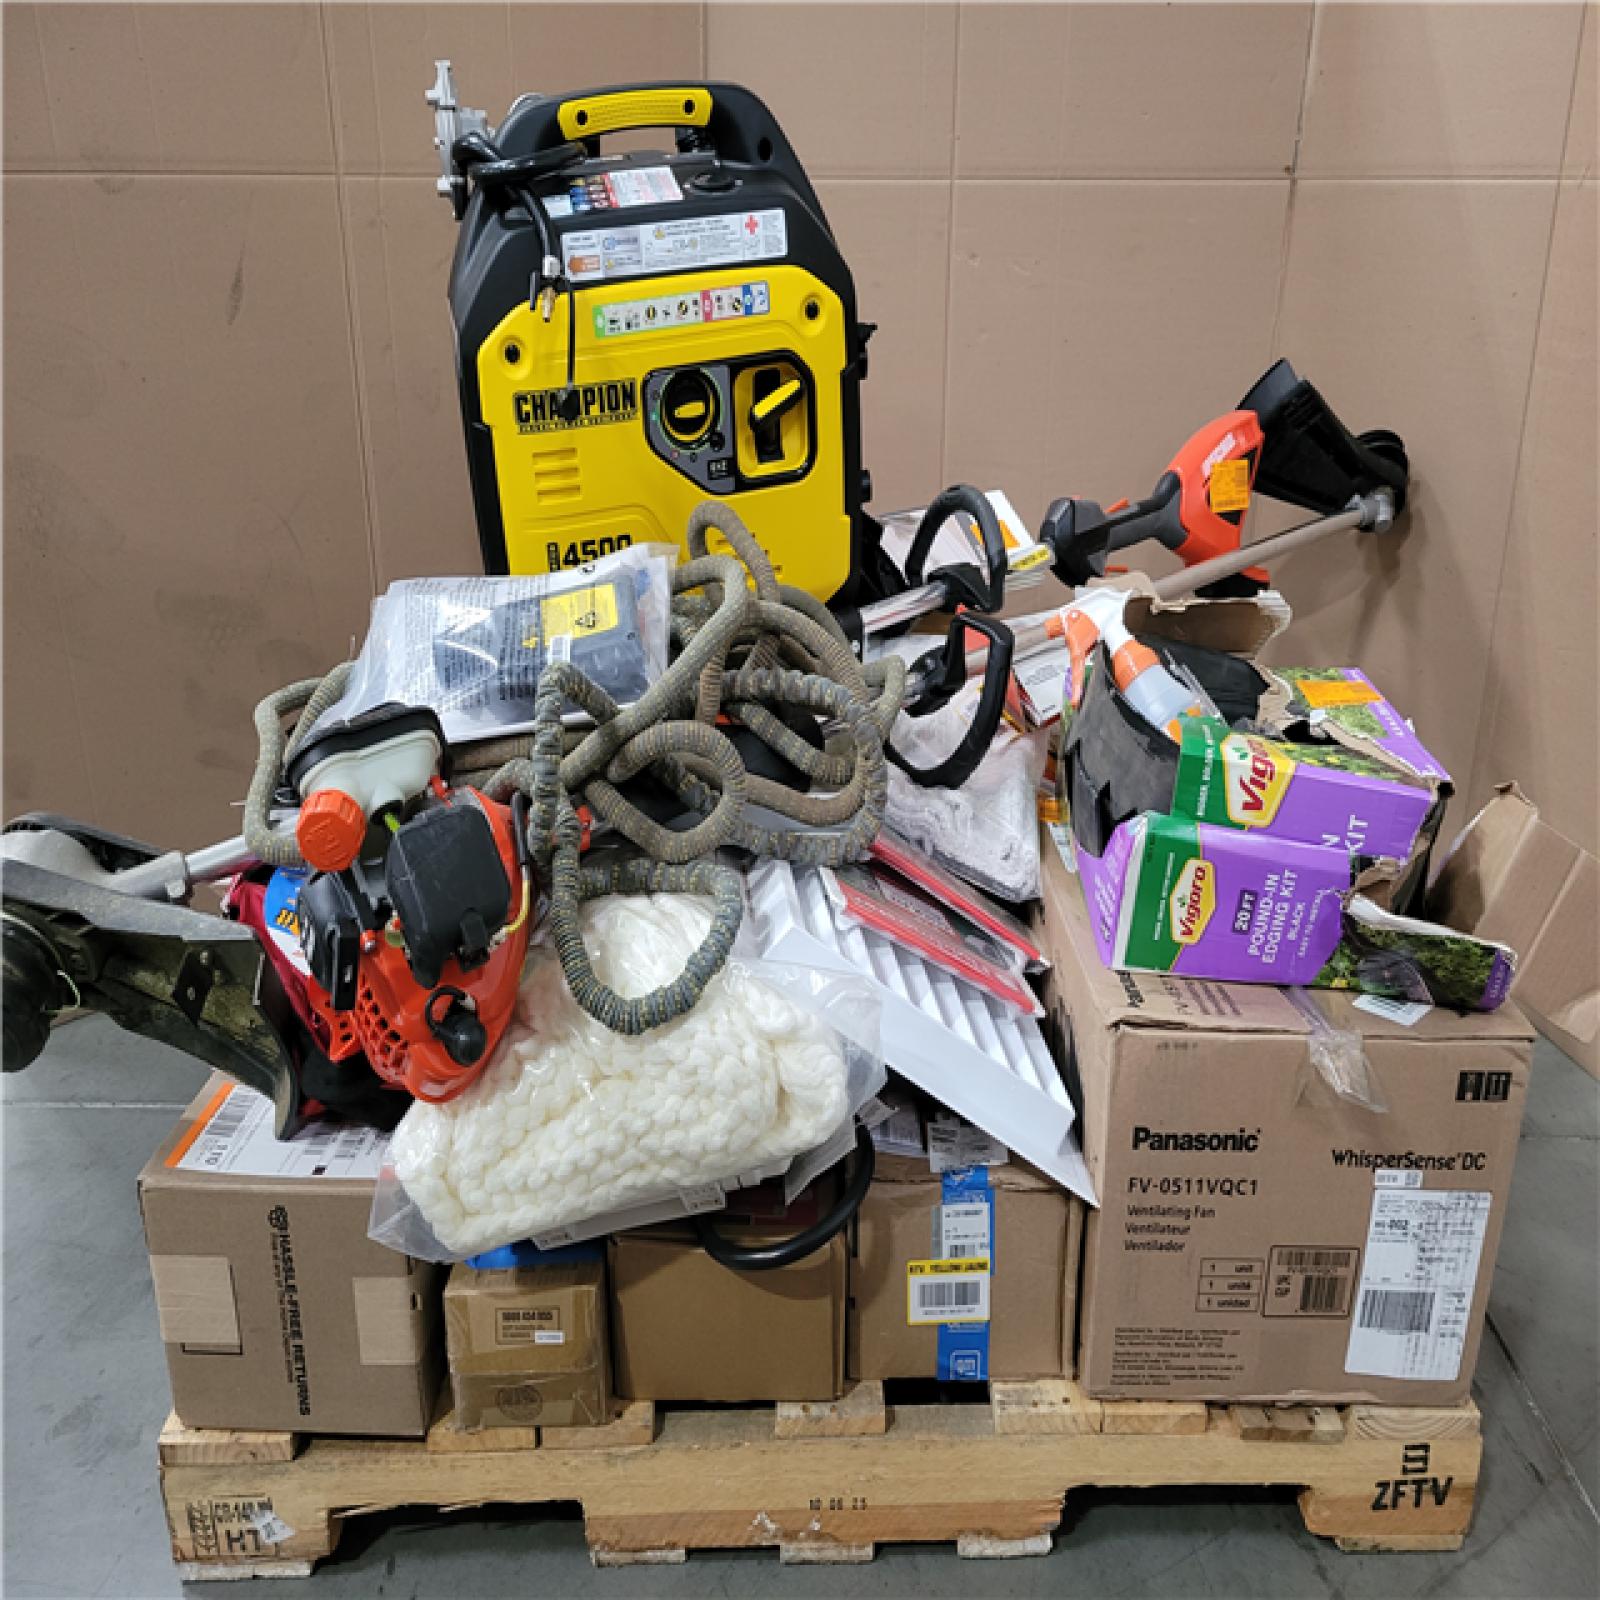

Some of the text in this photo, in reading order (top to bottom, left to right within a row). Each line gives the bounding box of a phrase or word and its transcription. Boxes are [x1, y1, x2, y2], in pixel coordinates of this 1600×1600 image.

[515, 381, 637, 421] CHAPION
[1180, 866, 1206, 936] Vigoro
[1248, 872, 1281, 956] POUND-IN
[1261, 867, 1298, 964] EDGING KIT
[1132, 1127, 1259, 1152] Panasonic
[1462, 1152, 1486, 1171] DC
[1127, 1176, 1258, 1196] FV-0511VQC1
[1126, 1204, 1216, 1220] Ventilating Fan
[1124, 1221, 1191, 1236] Ventilateur
[1123, 1239, 1186, 1252] Ventilador
[1234, 1264, 1254, 1273] unit
[1371, 1476, 1453, 1511] ZFTV
